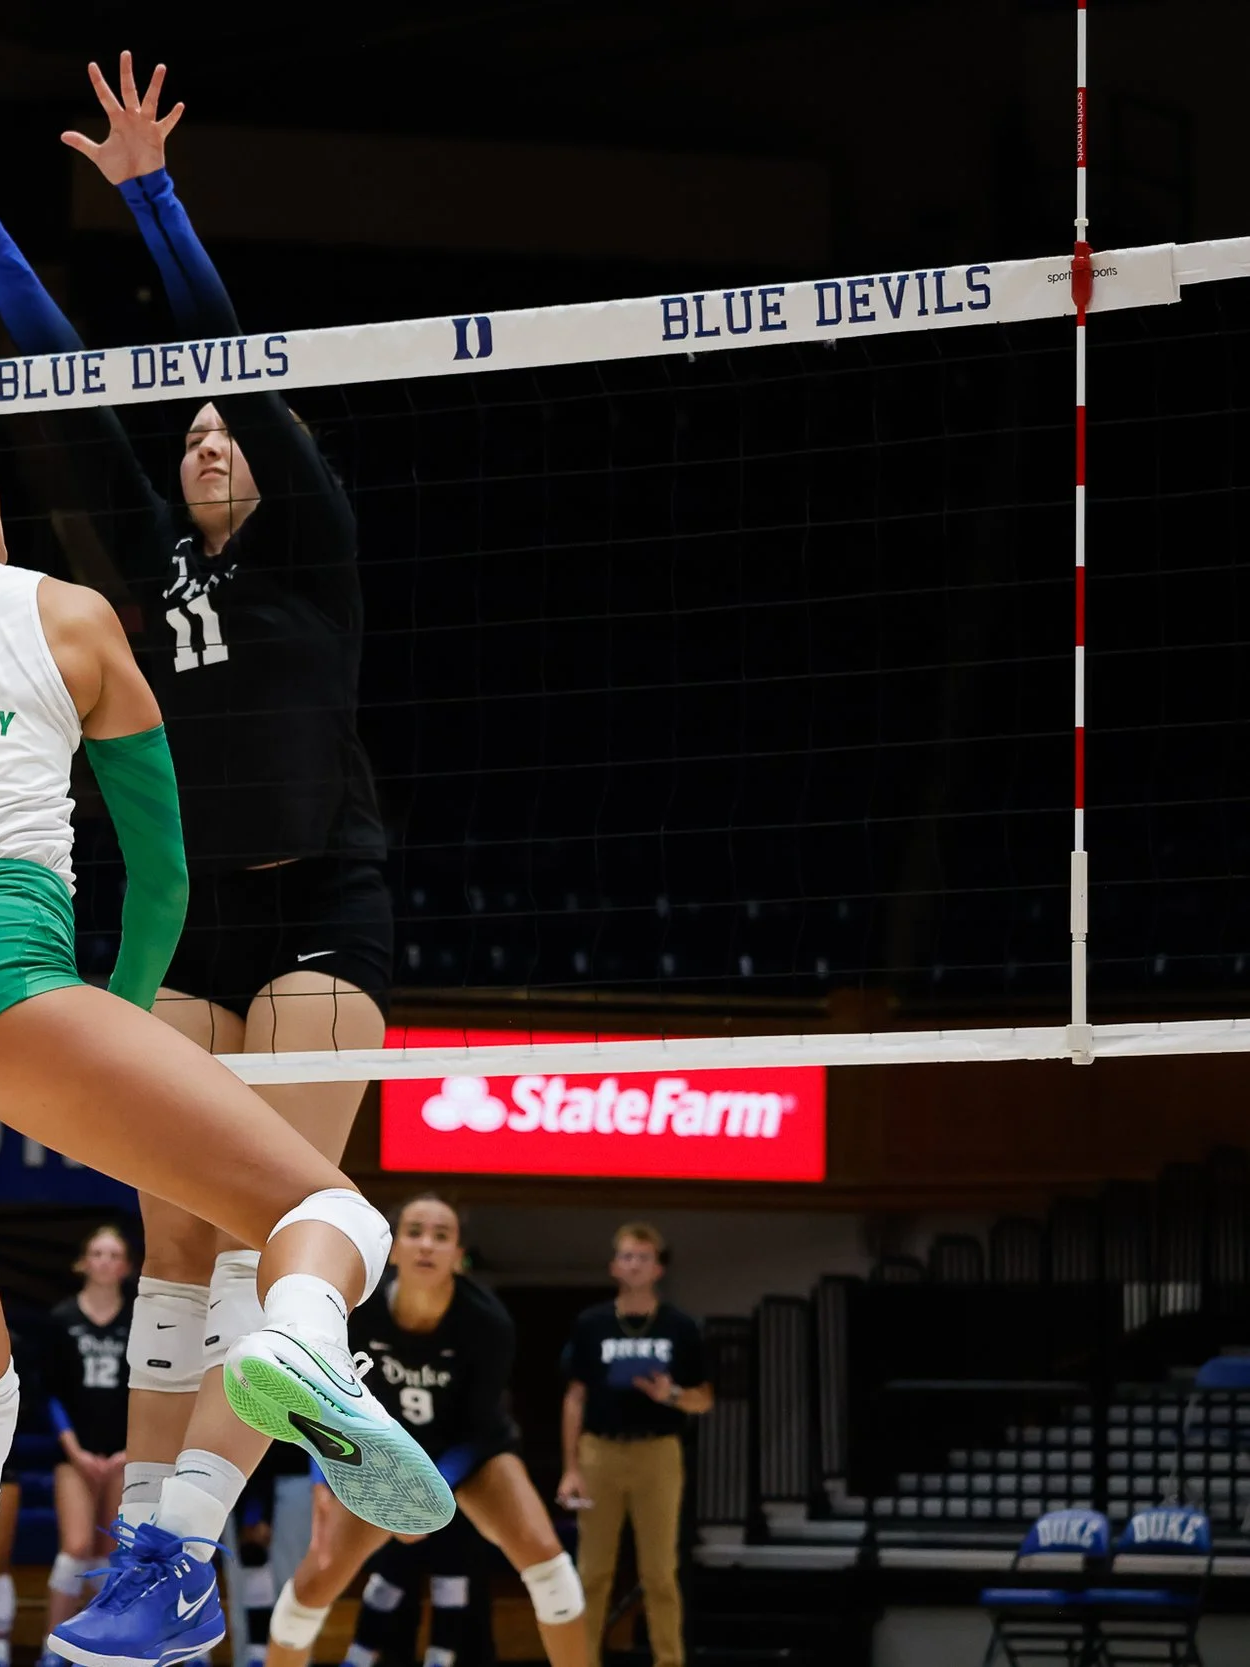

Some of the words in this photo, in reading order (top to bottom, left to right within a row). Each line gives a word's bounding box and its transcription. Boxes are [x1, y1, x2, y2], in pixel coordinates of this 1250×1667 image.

[660, 286, 787, 342] BLUE
[814, 265, 991, 327] DEVILS
[132, 335, 289, 389] DEVILS
[166, 592, 229, 673] 11
[83, 1355, 120, 1388] 12
[382, 1355, 451, 1388] Duke
[398, 1387, 435, 1425] 9
[1036, 1518, 1102, 1548] DUKE
[1131, 1511, 1205, 1545] DUKE
